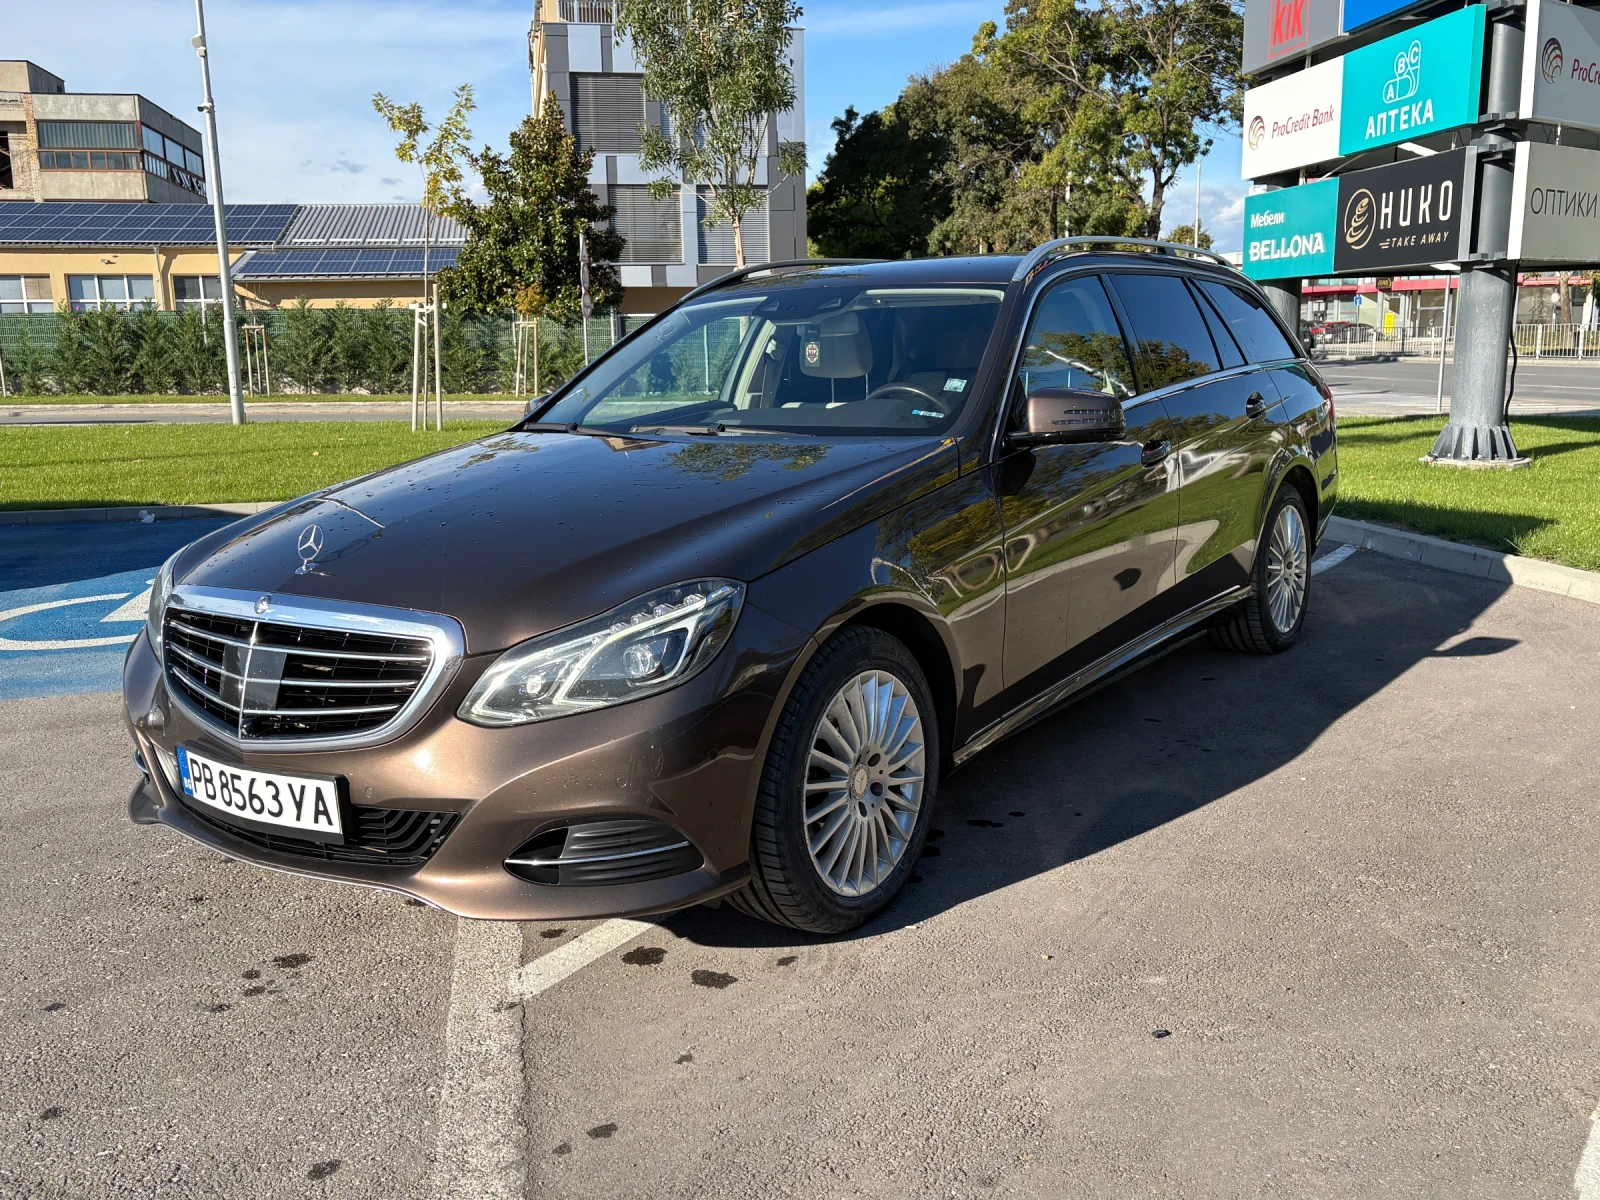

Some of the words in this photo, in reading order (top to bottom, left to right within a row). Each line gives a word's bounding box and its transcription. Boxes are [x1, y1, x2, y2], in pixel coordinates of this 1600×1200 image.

[1271, 113, 1311, 139] ProCredit
[1311, 104, 1335, 127] Bank
[1365, 98, 1434, 140] АПТЕКА
[1530, 187, 1598, 219] ОПТИКИ
[1250, 210, 1285, 229] Мебели
[1249, 232, 1326, 262] BELLONA
[1391, 235, 1417, 248] TAKE
[1420, 231, 1450, 245] AWAY
